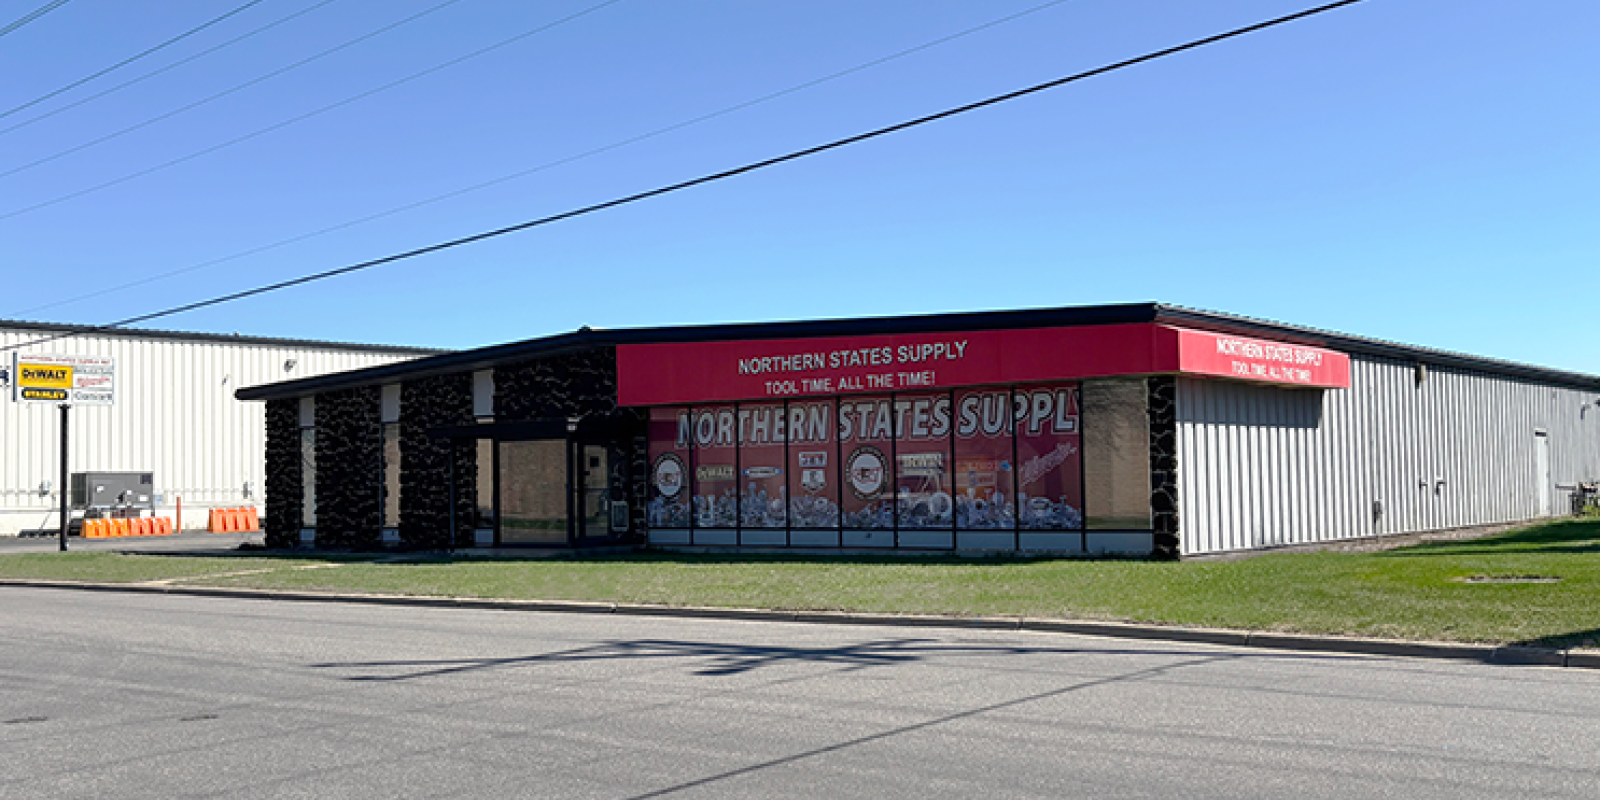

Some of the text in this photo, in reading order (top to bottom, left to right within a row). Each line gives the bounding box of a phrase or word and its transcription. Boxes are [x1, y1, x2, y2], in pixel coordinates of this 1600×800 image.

[738, 340, 968, 374] NORTHERN STATES SUPPLY
[1217, 338, 1323, 366] NORTHERN STATES SUPPLY
[764, 380, 799, 394] TOOL
[838, 376, 864, 390] ALL
[866, 373, 894, 388] THE
[897, 371, 936, 386] TIME!
[677, 391, 1080, 446] NORTHERN STATES SUPPL
